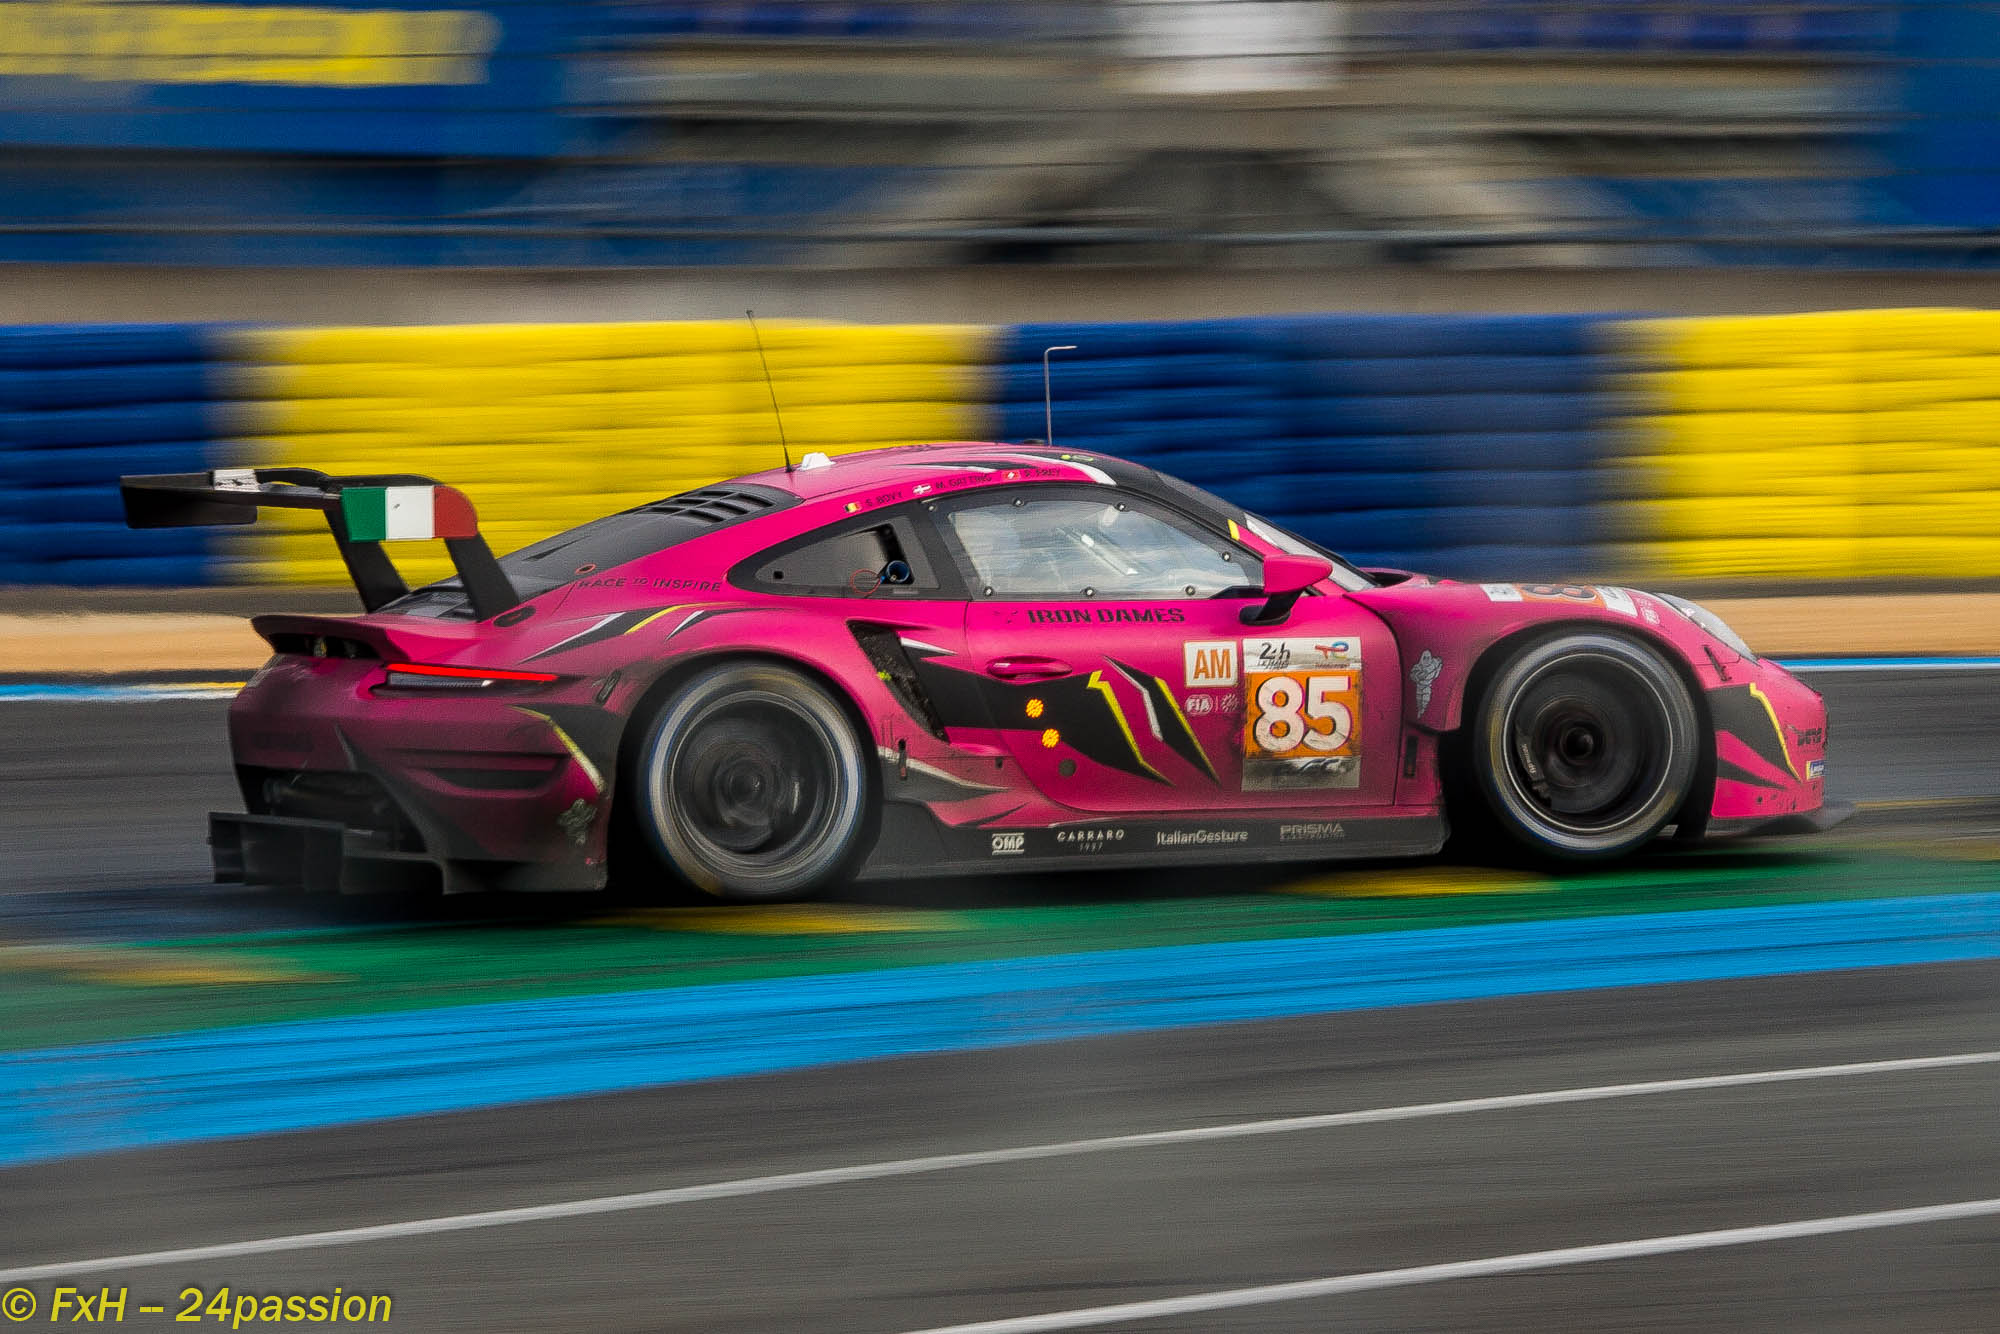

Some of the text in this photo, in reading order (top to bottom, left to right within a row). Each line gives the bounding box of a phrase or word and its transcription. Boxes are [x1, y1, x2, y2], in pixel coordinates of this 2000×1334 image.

[577, 578, 627, 588] RACE
[652, 577, 721, 592] INSPIRE
[1027, 607, 1185, 623] IRON DAMES
[1193, 648, 1231, 679] AM
[1186, 698, 1211, 713] FIA
[1253, 676, 1353, 752] 85
[1056, 829, 1125, 842] CARRARO
[1280, 823, 1344, 834] PRISMA
[992, 835, 1025, 851] OMP
[1156, 829, 1249, 845] ItalianGesture
